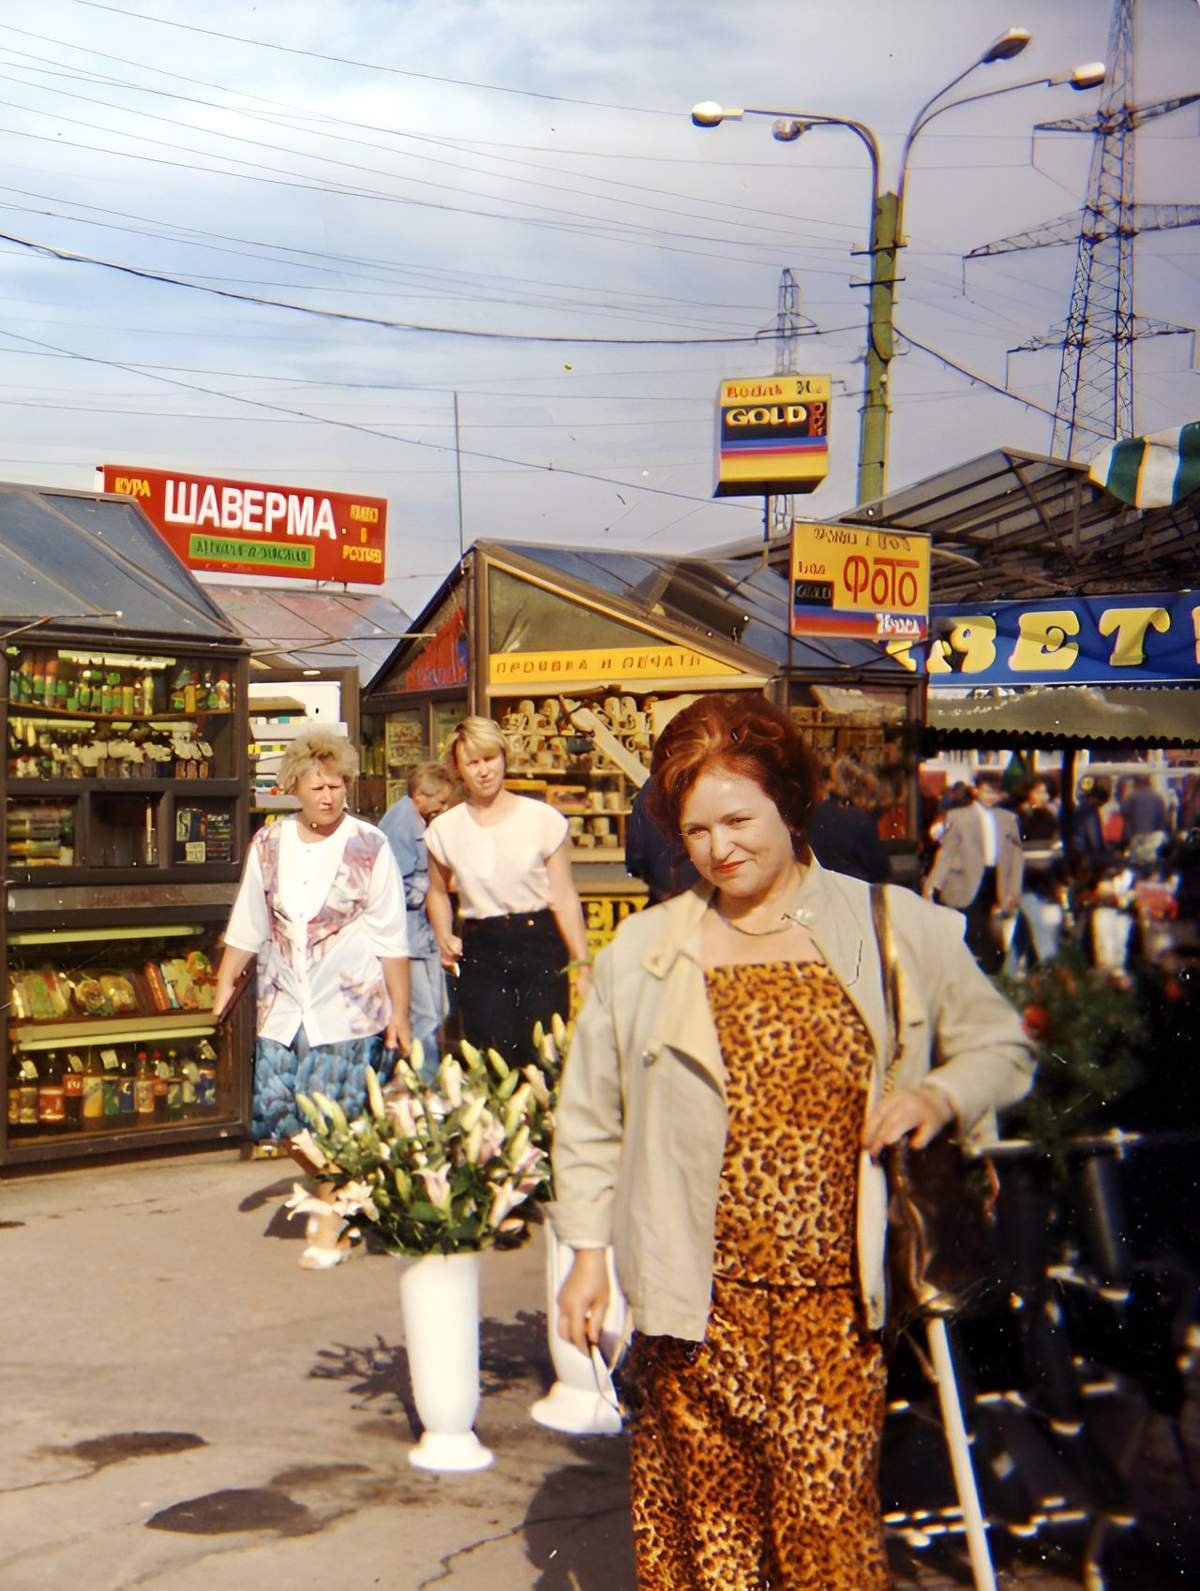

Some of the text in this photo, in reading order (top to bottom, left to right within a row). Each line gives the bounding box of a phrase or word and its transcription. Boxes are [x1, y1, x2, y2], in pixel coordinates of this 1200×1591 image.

[725, 405, 808, 426] GOLD
[164, 479, 337, 540] ШАВЕРМА
[843, 555, 920, 607] ФОТО
[884, 606, 1200, 674] ВЕТ
